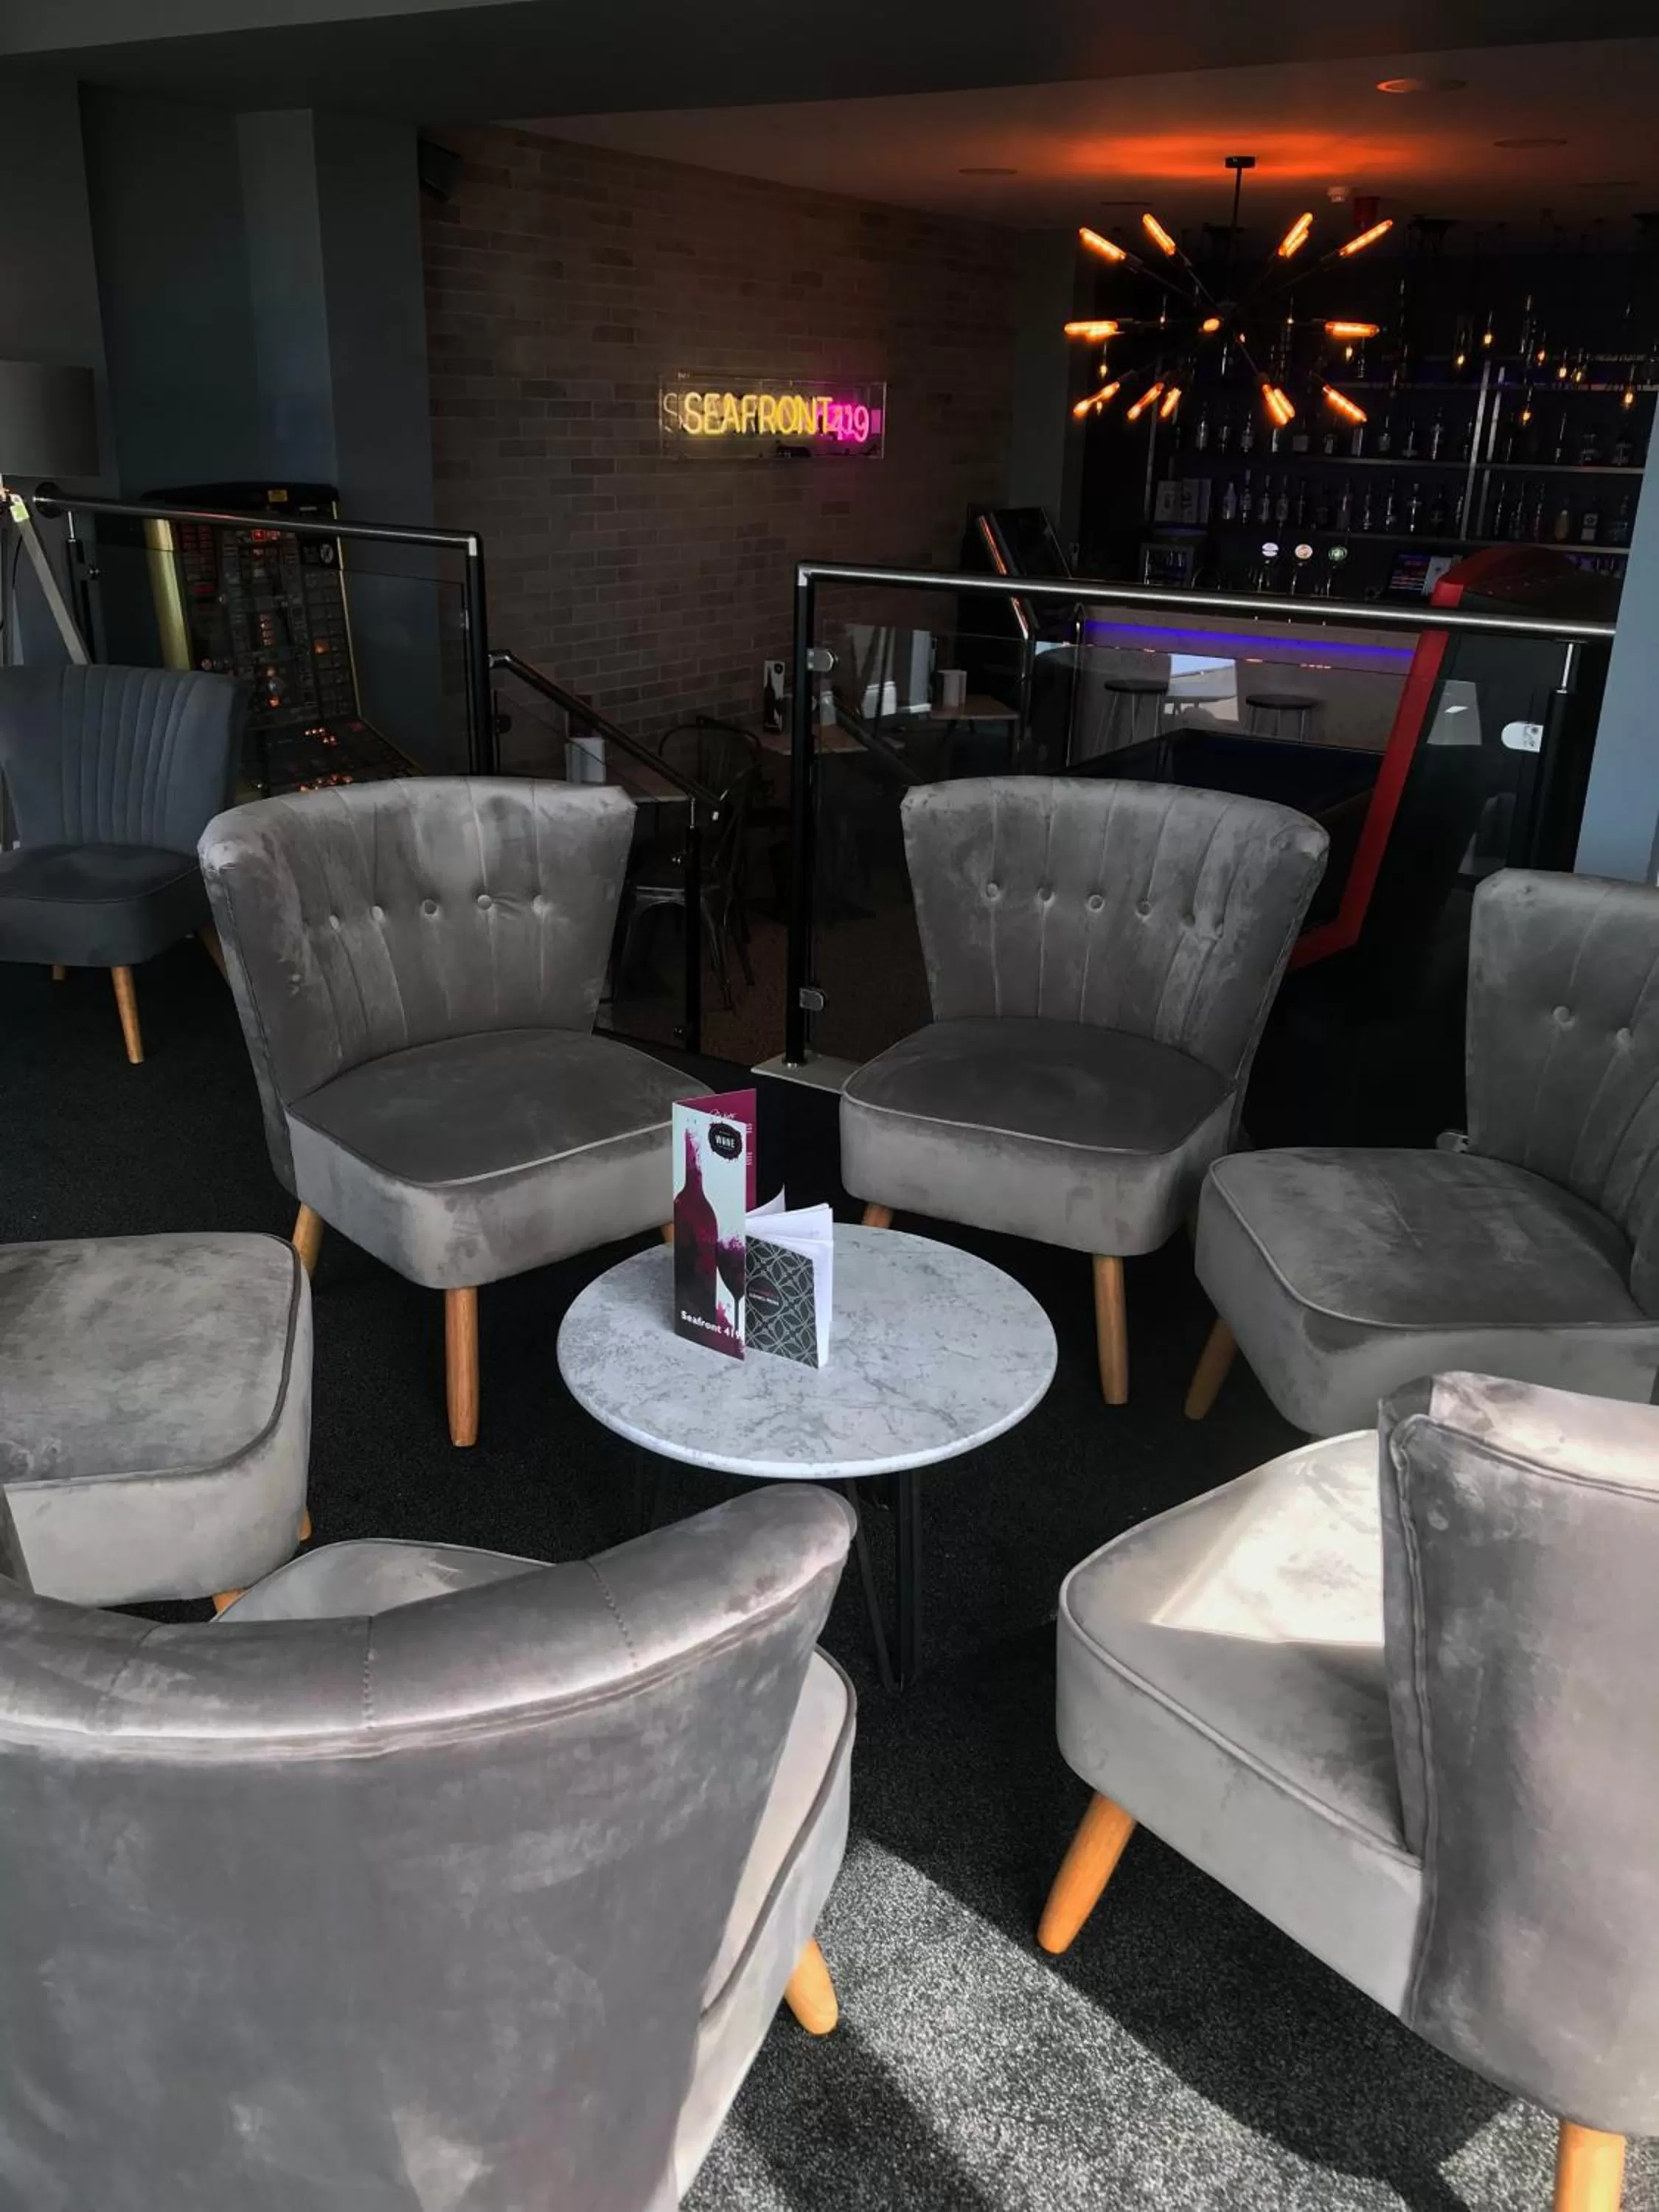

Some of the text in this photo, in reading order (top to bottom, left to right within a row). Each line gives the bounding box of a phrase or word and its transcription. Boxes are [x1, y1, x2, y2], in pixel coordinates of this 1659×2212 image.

[684, 392, 869, 442] SEAFRONT 419
[714, 1134, 736, 1149] WINE
[681, 1310, 740, 1340] Seafront 419
